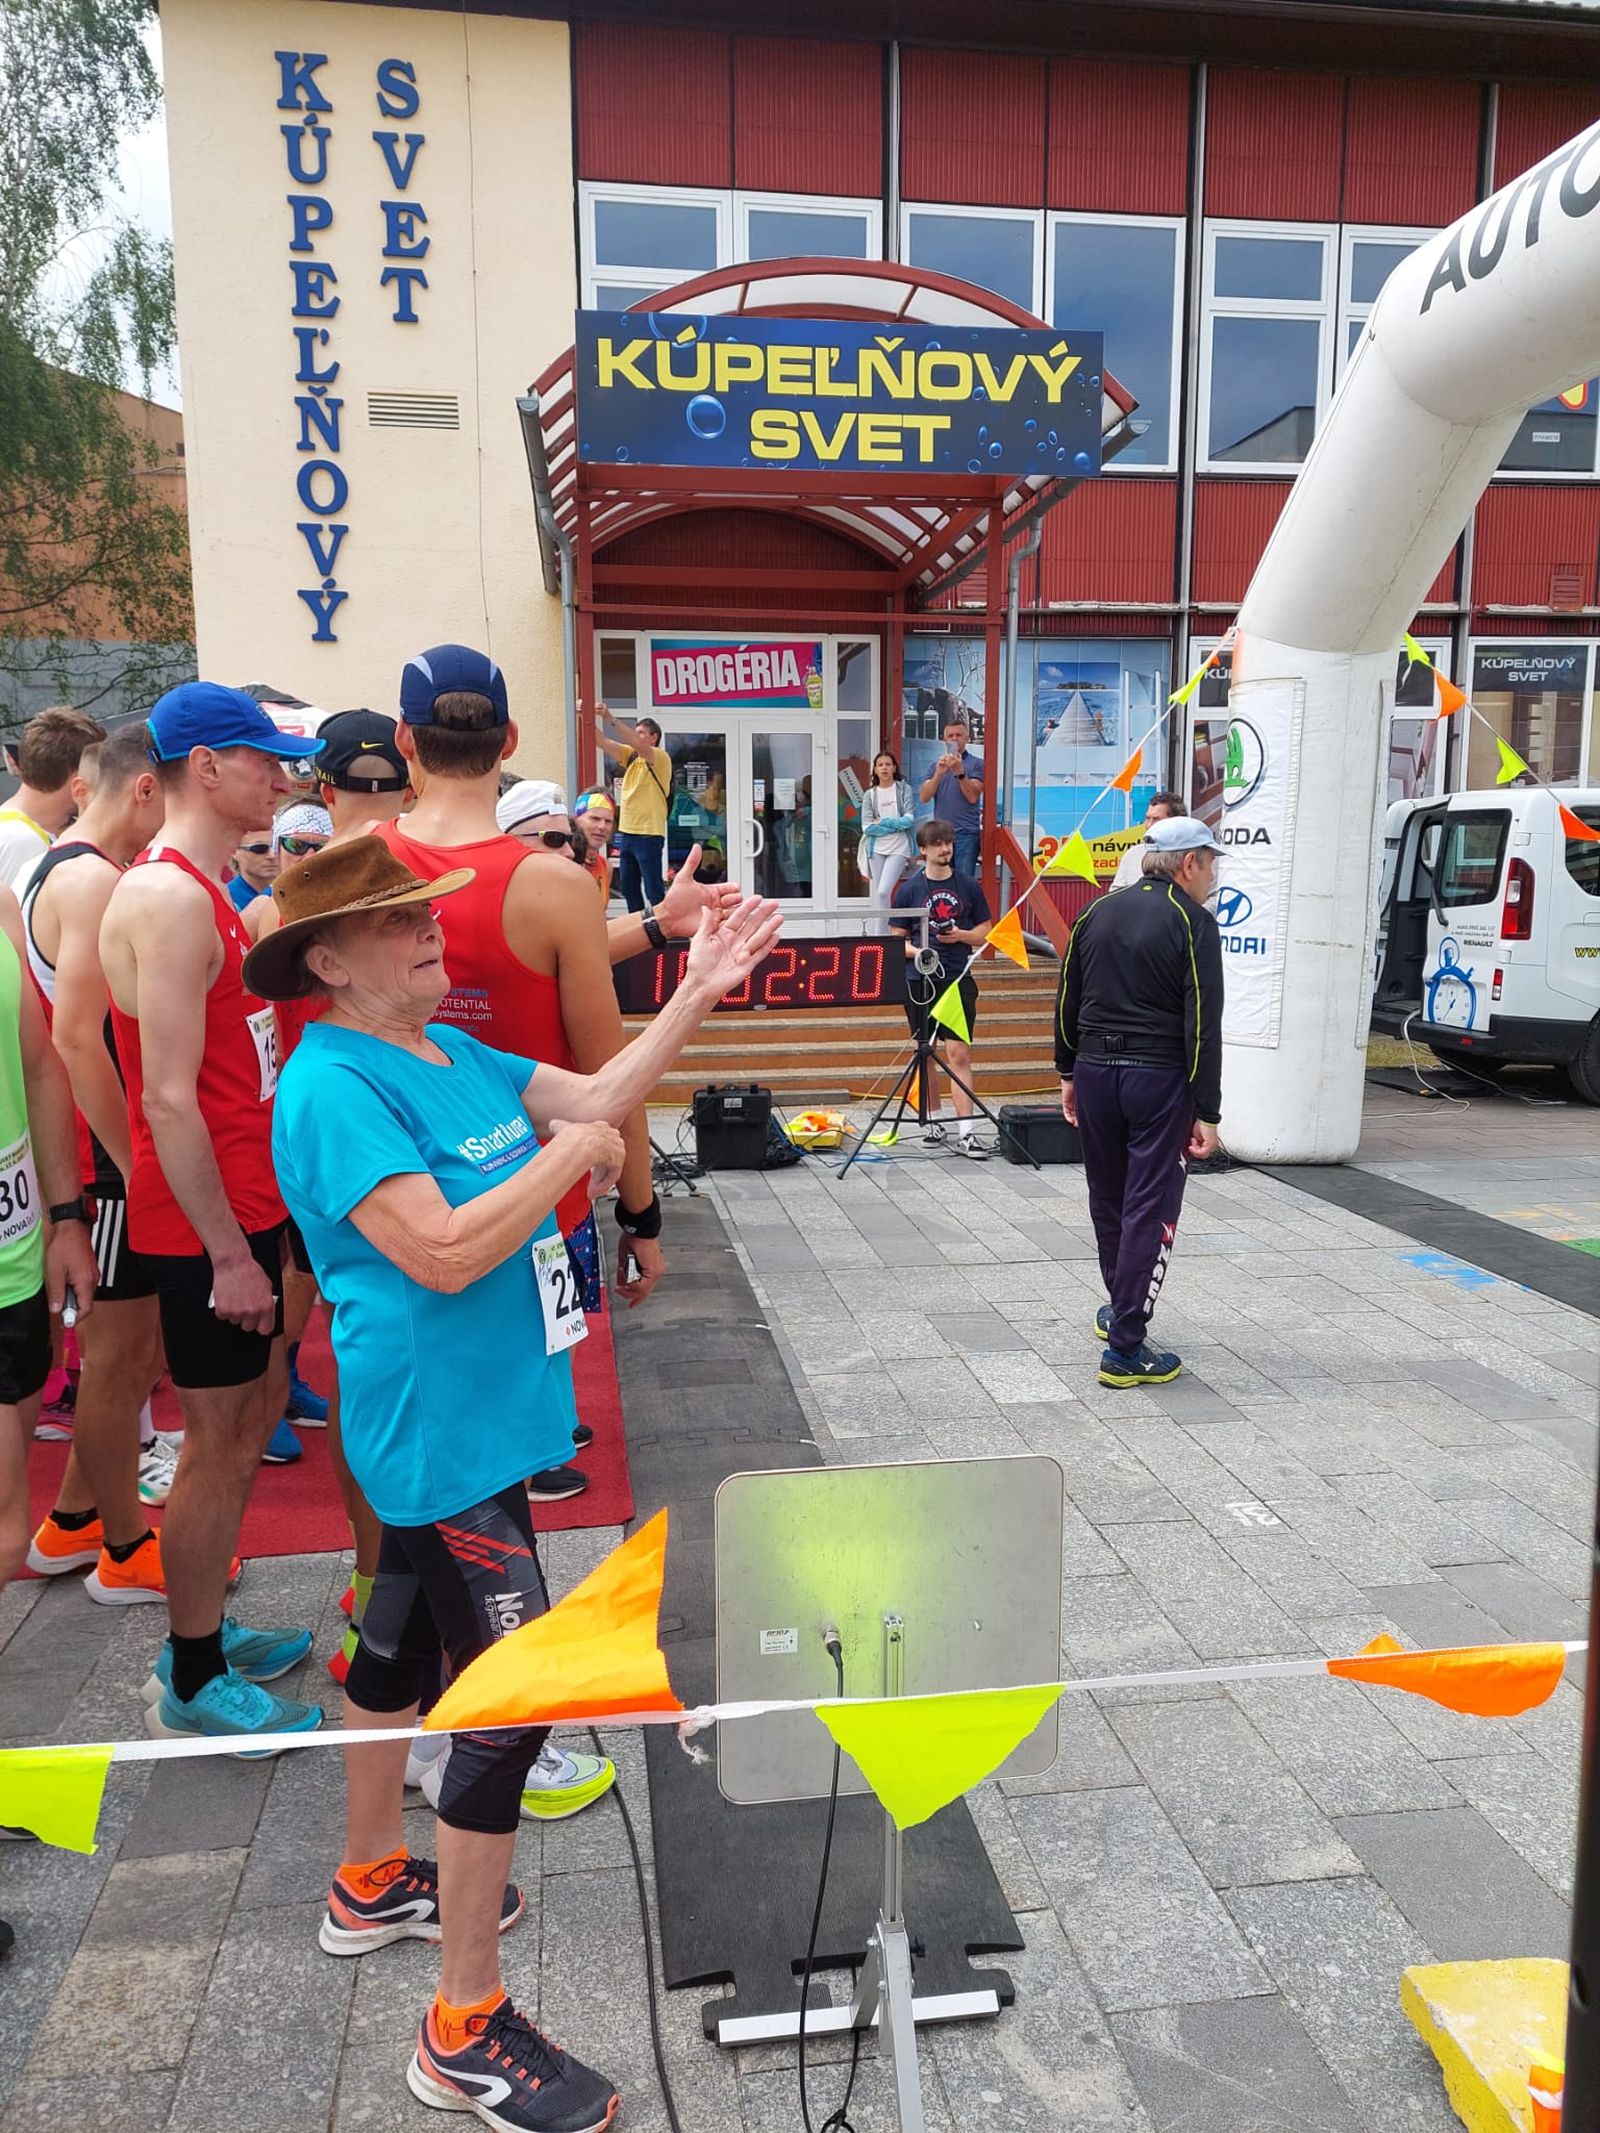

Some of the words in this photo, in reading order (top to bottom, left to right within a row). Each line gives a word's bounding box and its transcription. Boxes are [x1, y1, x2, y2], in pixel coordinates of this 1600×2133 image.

[373, 58, 431, 323] SVET
[274, 51, 348, 642] KÚPEĽŇOVÝ
[596, 325, 1082, 404] KÚPEĽŇOVÝ
[750, 409, 951, 463] SVET
[656, 644, 801, 696] DROGÉRIA
[1481, 657, 1576, 669] KÚPEĽŇOVÝ
[1508, 672, 1549, 682] SVET
[1093, 857, 1121, 868] zad
